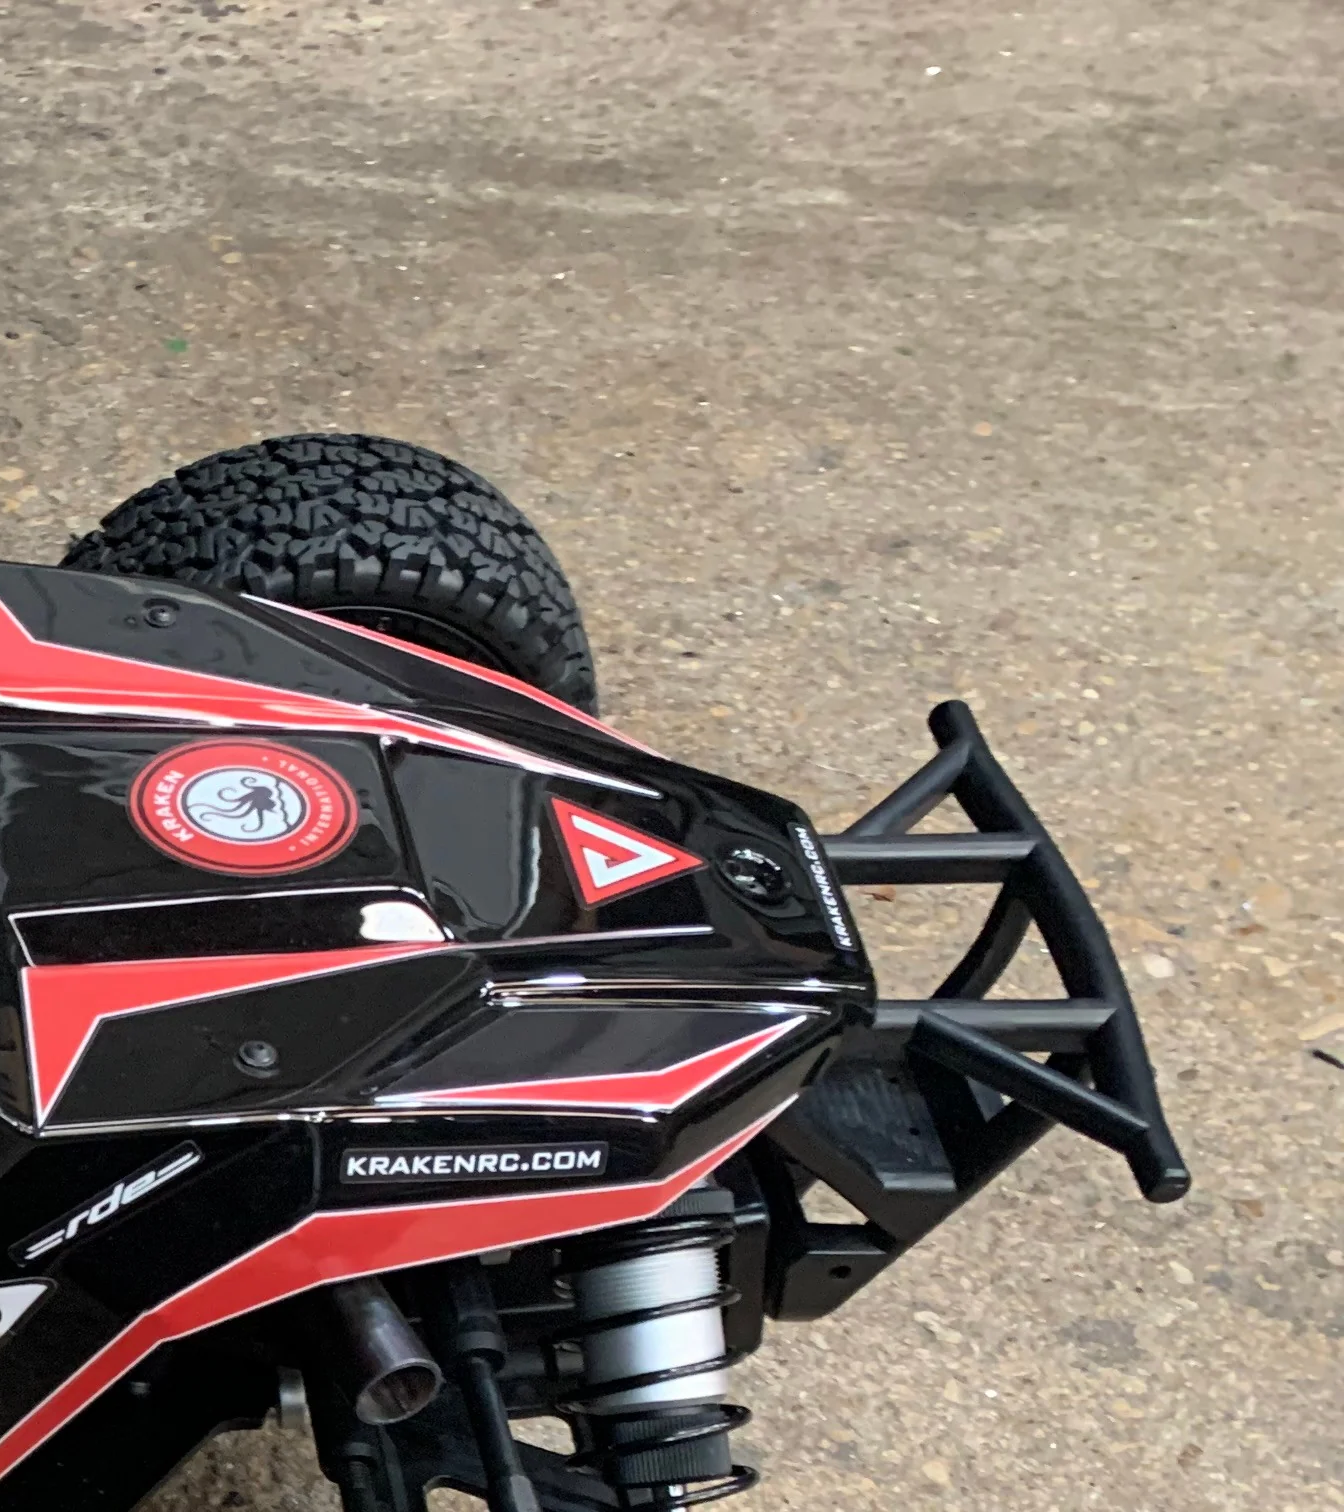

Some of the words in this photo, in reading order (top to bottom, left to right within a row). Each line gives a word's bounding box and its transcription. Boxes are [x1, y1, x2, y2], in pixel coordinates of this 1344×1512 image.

[153, 769, 195, 842] KRAKEN
[278, 759, 333, 846] INTERNATIONAL
[794, 827, 853, 947] KRAKENRC.COM
[345, 1150, 602, 1177] KRAKENRC.COM
